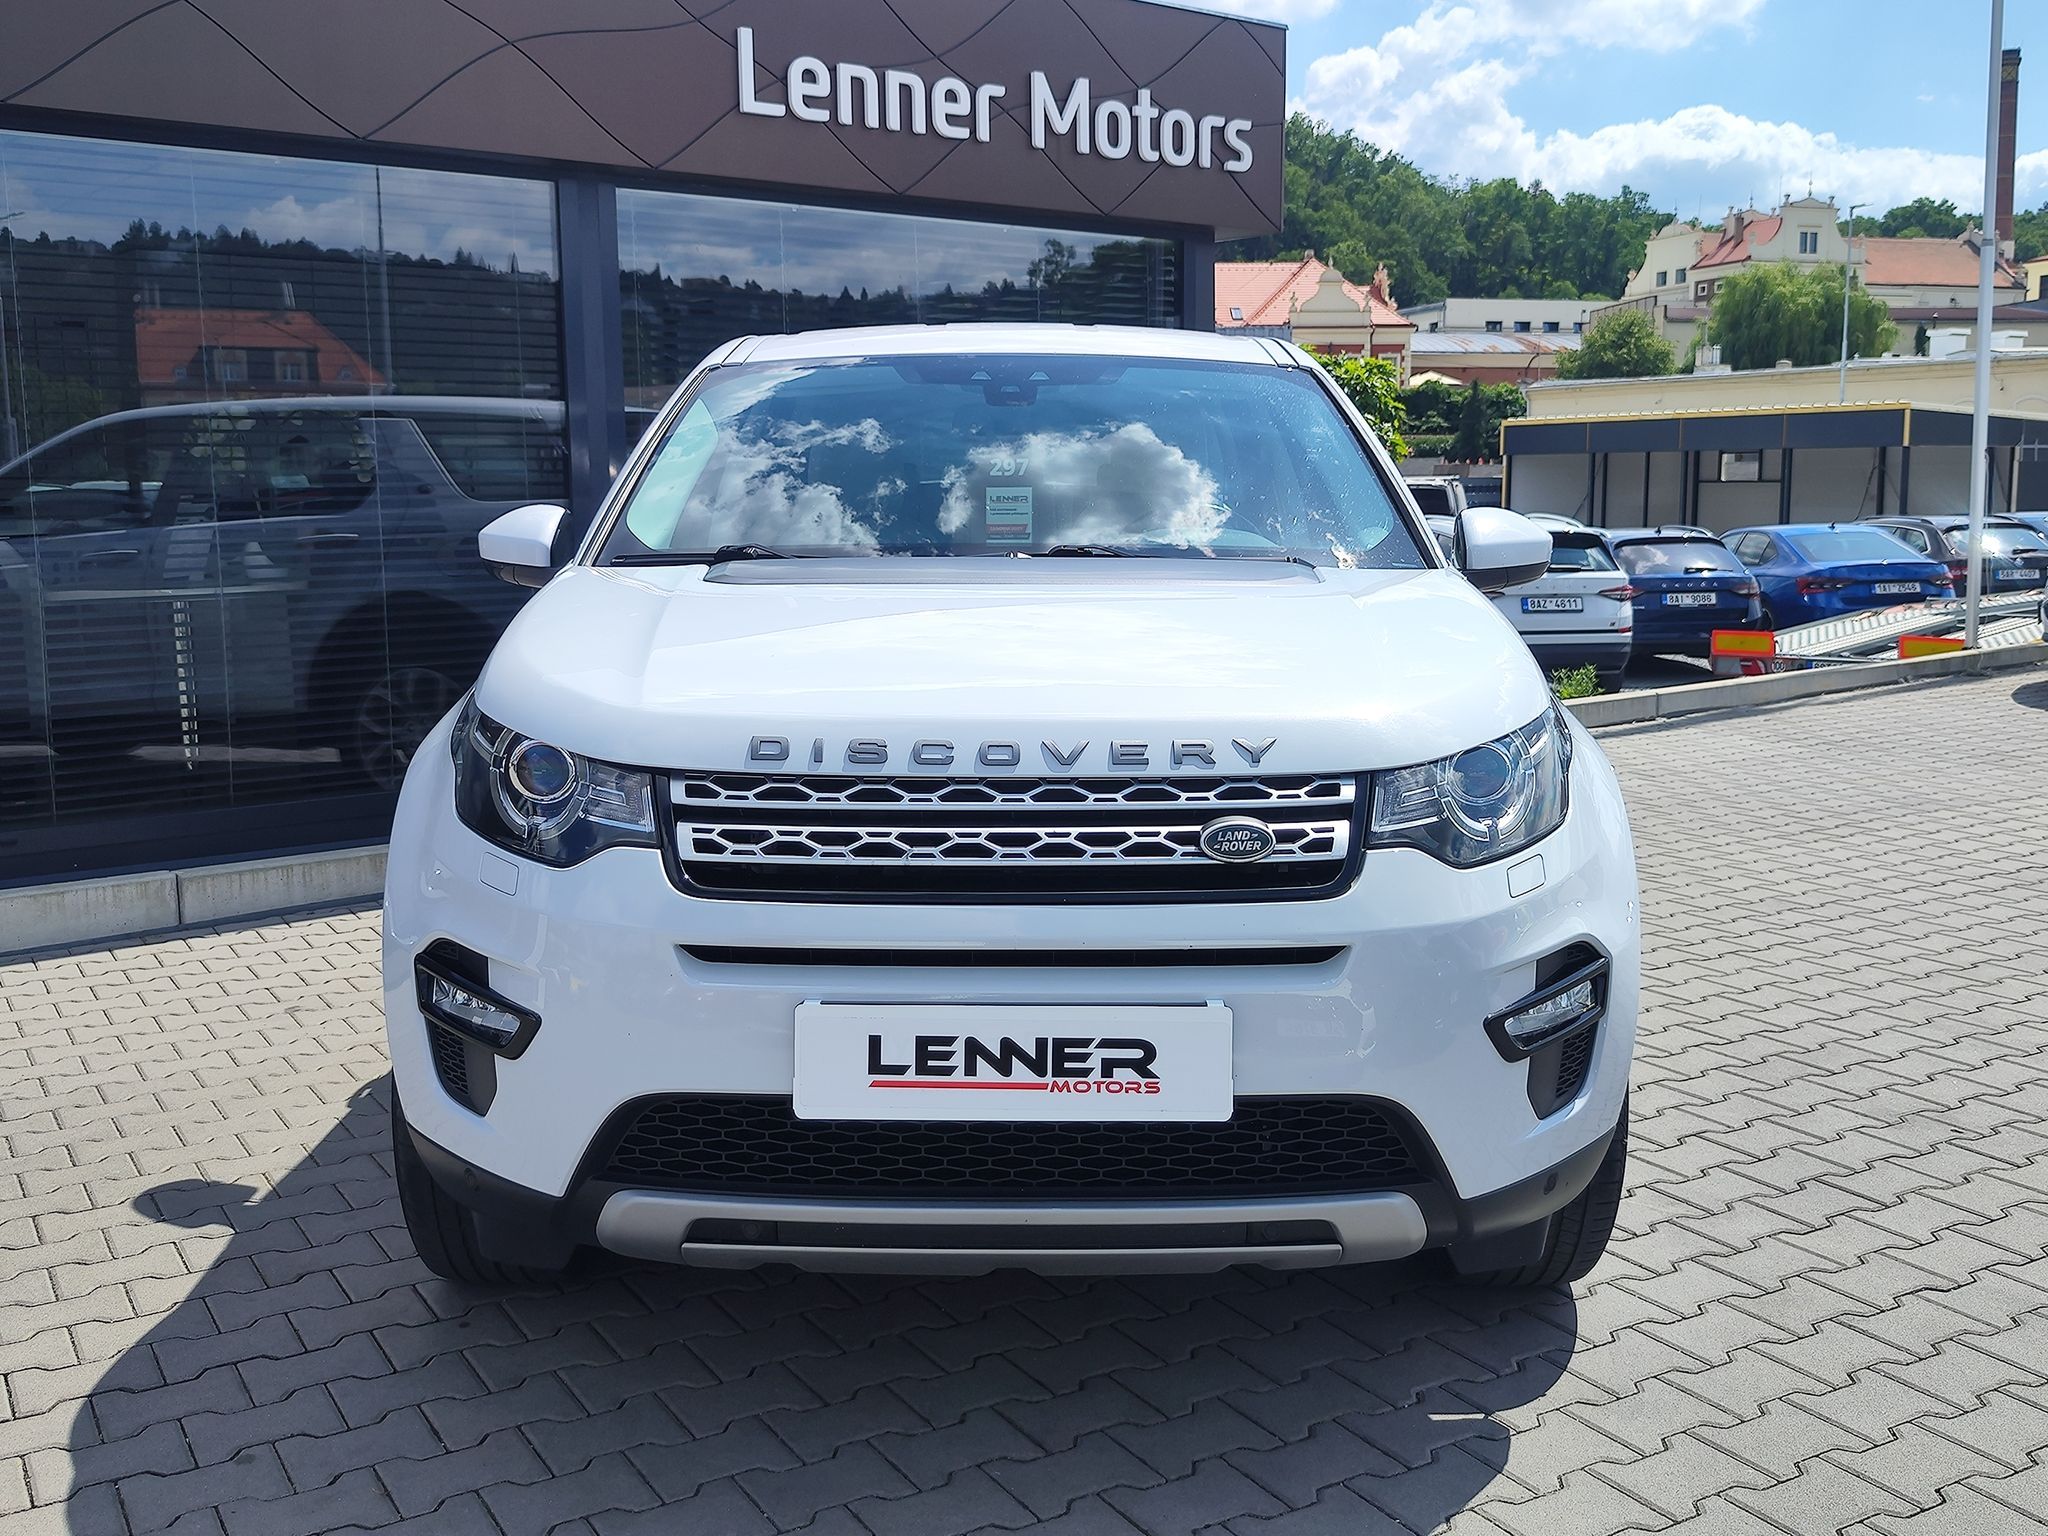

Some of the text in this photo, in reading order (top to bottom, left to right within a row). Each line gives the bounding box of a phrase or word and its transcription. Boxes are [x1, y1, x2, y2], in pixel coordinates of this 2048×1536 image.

[736, 26, 1254, 173] Lenner Motors
[989, 458, 1029, 476] 297
[1529, 598, 1578, 609] 8AZ 4611
[1668, 594, 1684, 605] 8AI
[750, 735, 1279, 767] DISCOVERY
[1217, 830, 1251, 841] LAND
[1220, 840, 1262, 852] ROVER
[867, 1034, 1161, 1080] LENNER
[1049, 1080, 1161, 1094] MOTORS
